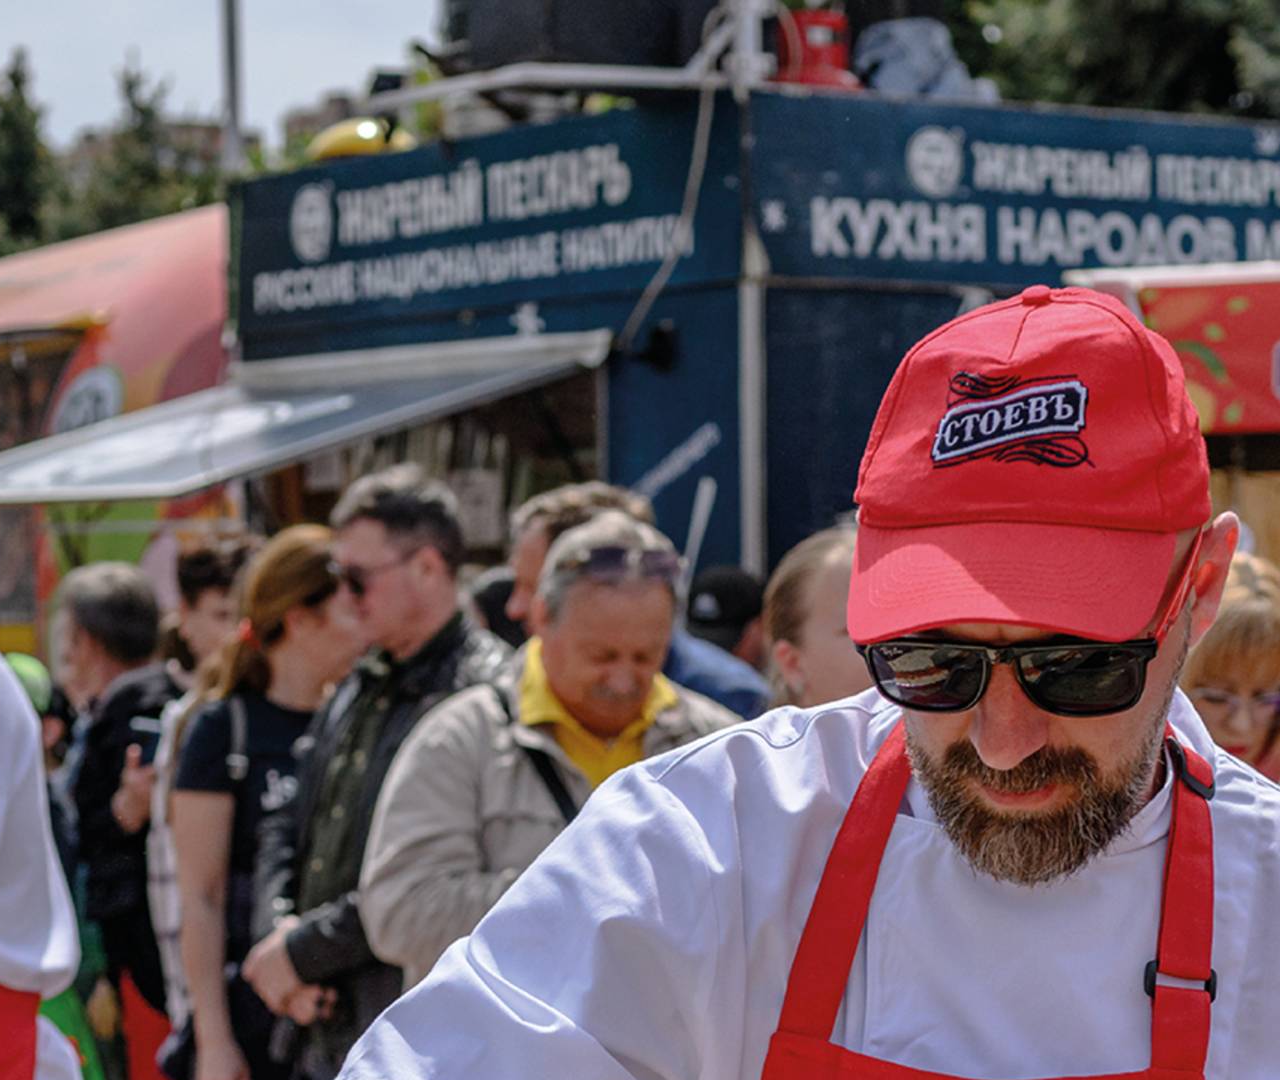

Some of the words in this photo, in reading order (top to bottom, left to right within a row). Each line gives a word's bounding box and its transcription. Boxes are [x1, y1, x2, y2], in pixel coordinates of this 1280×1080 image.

[337, 160, 483, 245] ЖАРЕНЫЙ
[486, 144, 631, 219] ПЕСКАРЬ
[973, 142, 1152, 200] ЖАРЕНЫЙ
[809, 196, 987, 262] КУХНЯ
[996, 208, 1237, 266] НАРОДОВ
[943, 393, 1074, 447] СТОЕВЪ
